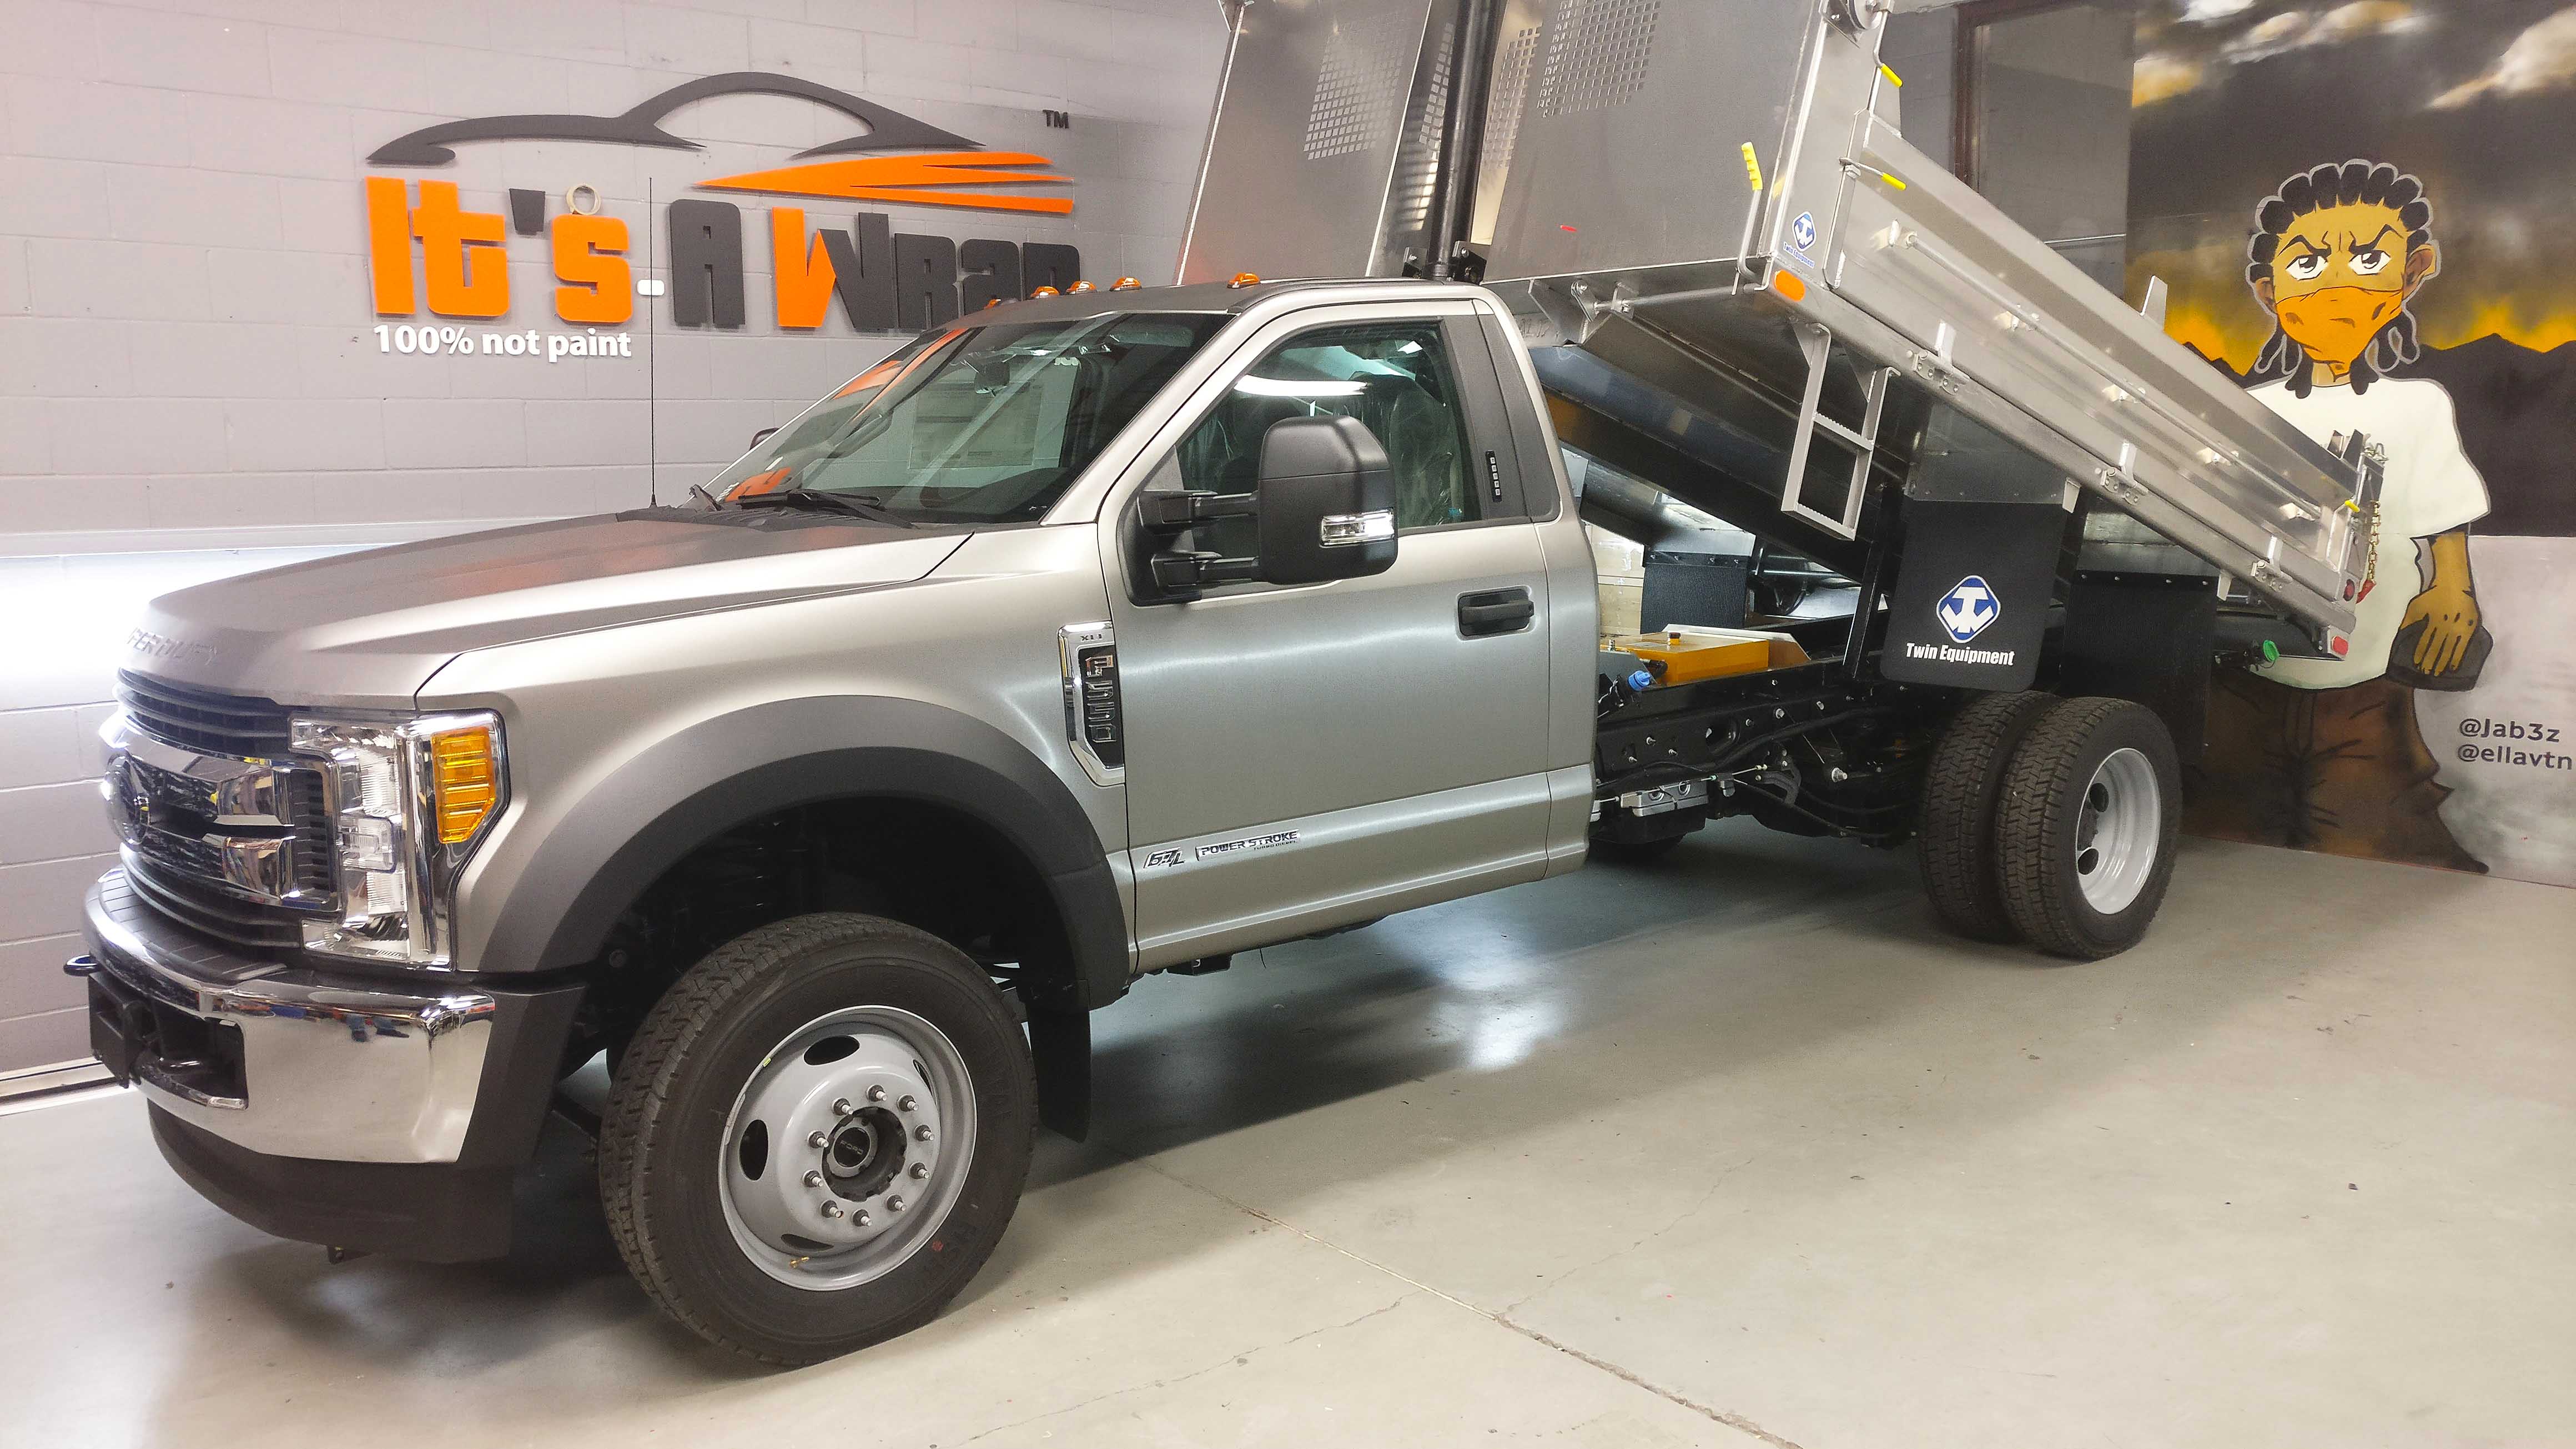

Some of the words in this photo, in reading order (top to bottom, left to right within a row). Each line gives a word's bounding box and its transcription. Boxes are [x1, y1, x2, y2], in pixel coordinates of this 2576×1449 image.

[1043, 109, 1069, 129] TM
[365, 176, 633, 323] It's
[670, 199, 745, 329] A
[374, 324, 475, 355] 100%
[482, 329, 541, 356] not
[547, 328, 632, 363] paint
[1906, 642, 1938, 660] Twin
[1939, 645, 2015, 666] Equipment
[2459, 718, 2560, 743] @Jab3z
[2457, 744, 2573, 770] @ellavtn
[1201, 840, 1245, 856] POWER
[1248, 831, 1298, 847] STROKE
